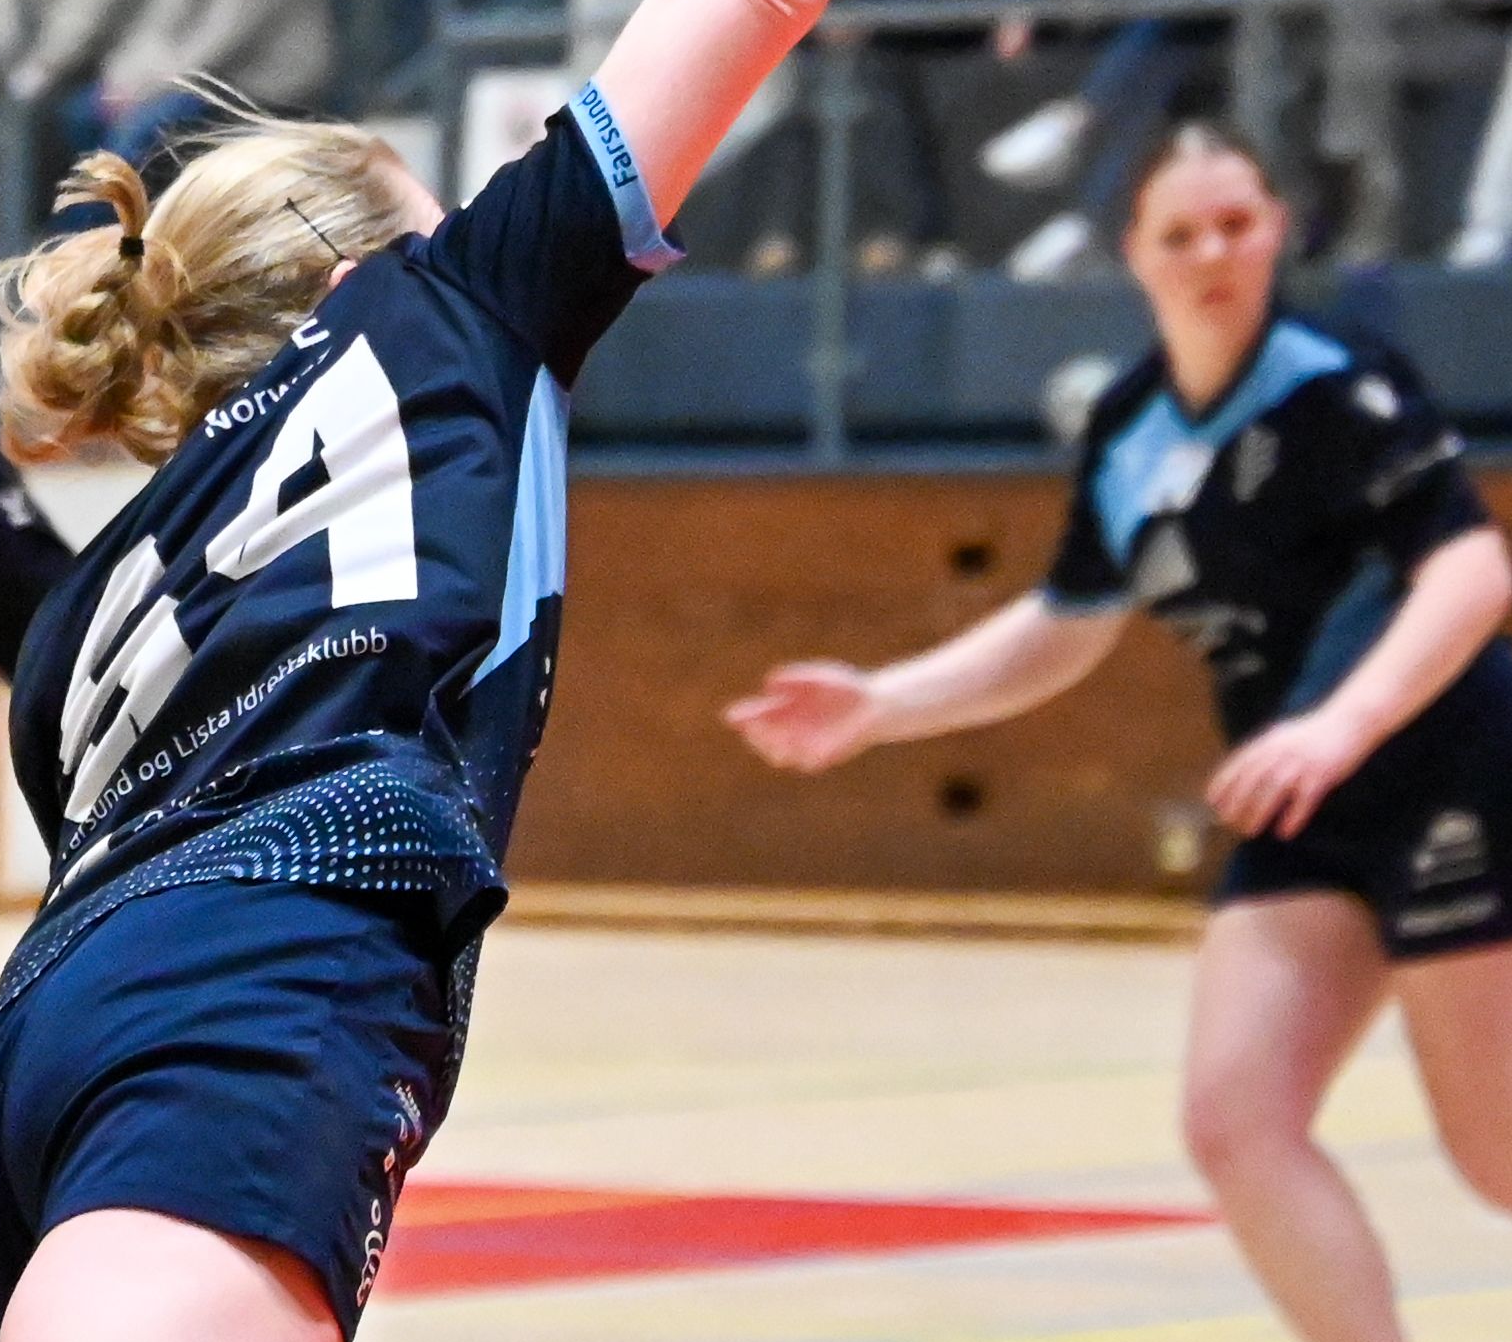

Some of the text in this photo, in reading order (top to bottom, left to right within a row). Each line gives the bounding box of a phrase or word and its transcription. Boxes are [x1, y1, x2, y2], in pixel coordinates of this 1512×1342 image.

[578, 88, 639, 189] Farsund
[61, 768, 133, 860] arsund
[138, 749, 173, 779] og
[172, 708, 231, 758] Lista
